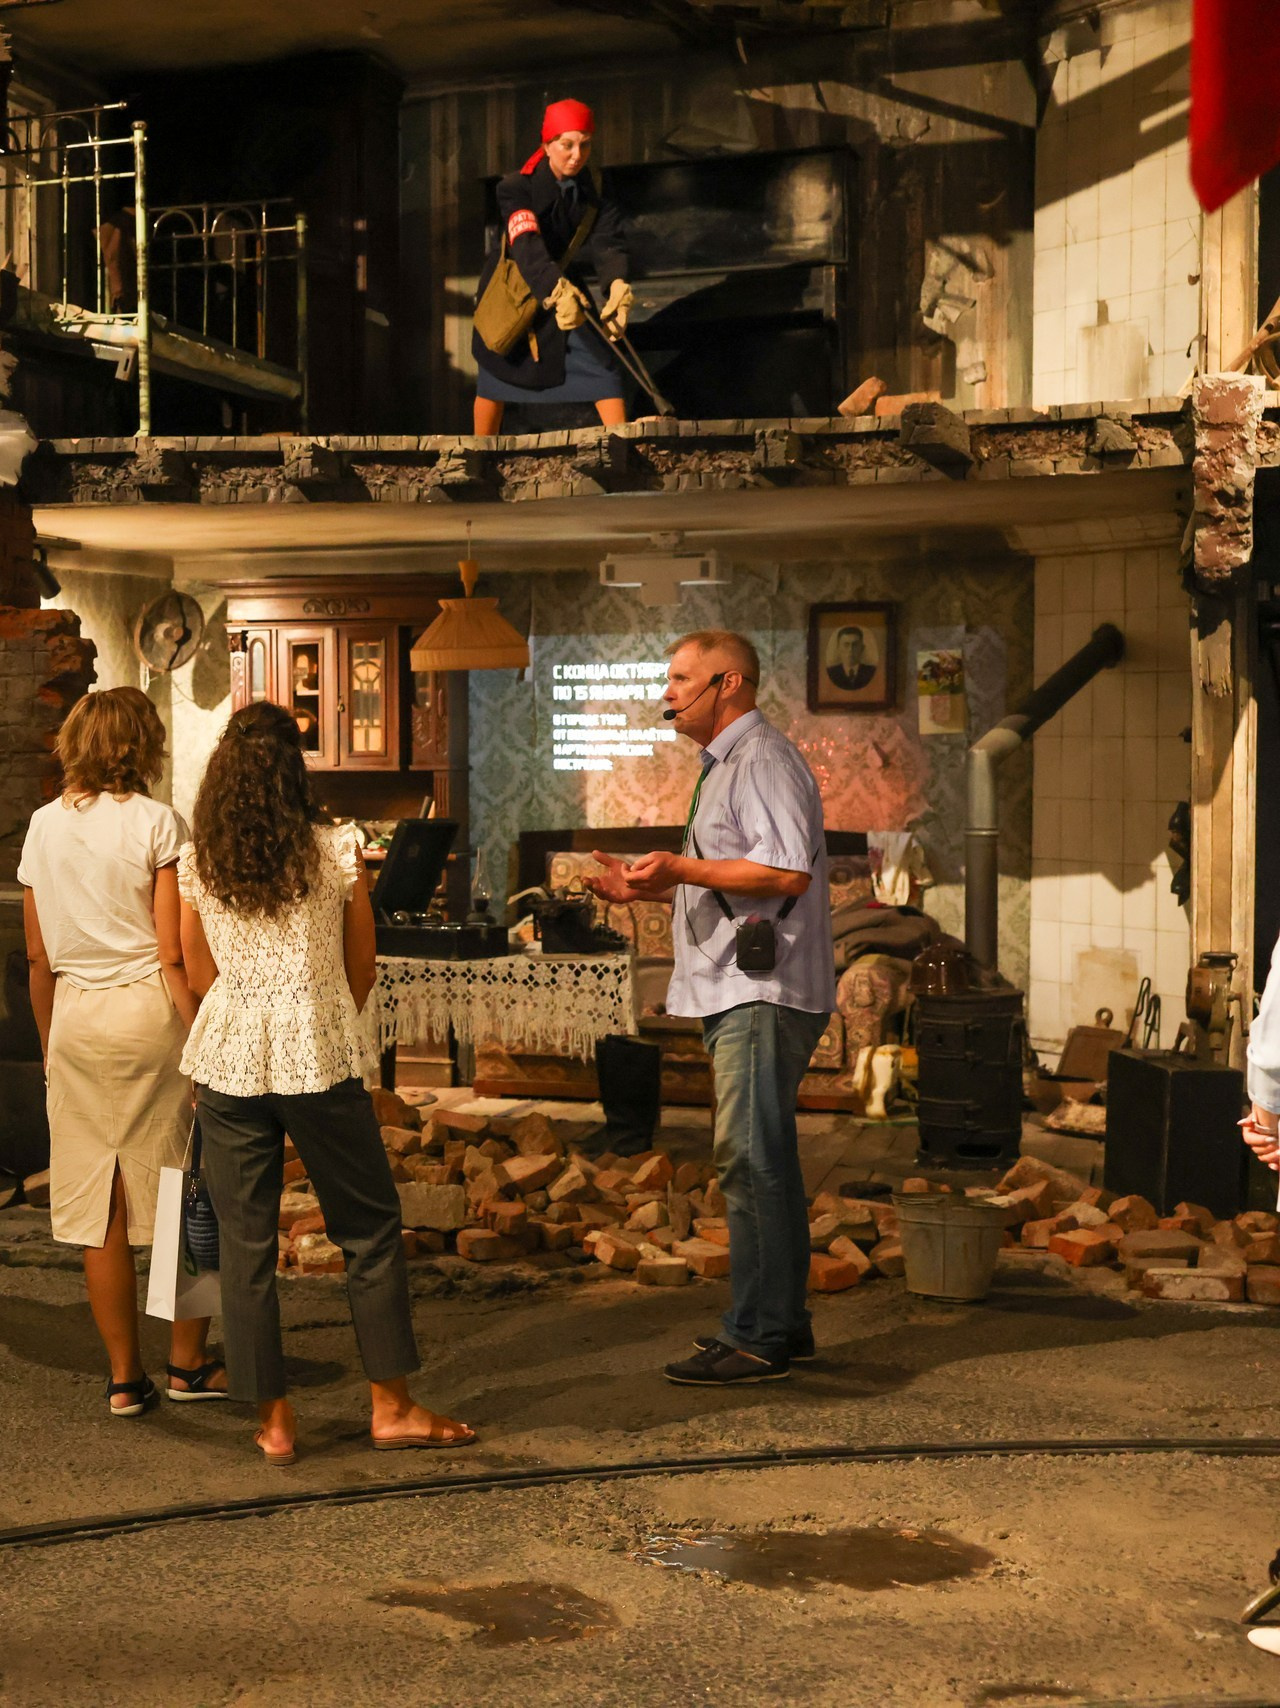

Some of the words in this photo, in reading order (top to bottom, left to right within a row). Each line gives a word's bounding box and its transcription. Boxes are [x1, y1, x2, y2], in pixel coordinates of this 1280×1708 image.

[564, 664, 609, 680] КОНЦА
[610, 663, 670, 679] ОКТЯБР
[553, 686, 572, 700] ПО
[574, 686, 588, 700] 15
[589, 685, 644, 700] ЯНВАРЯ
